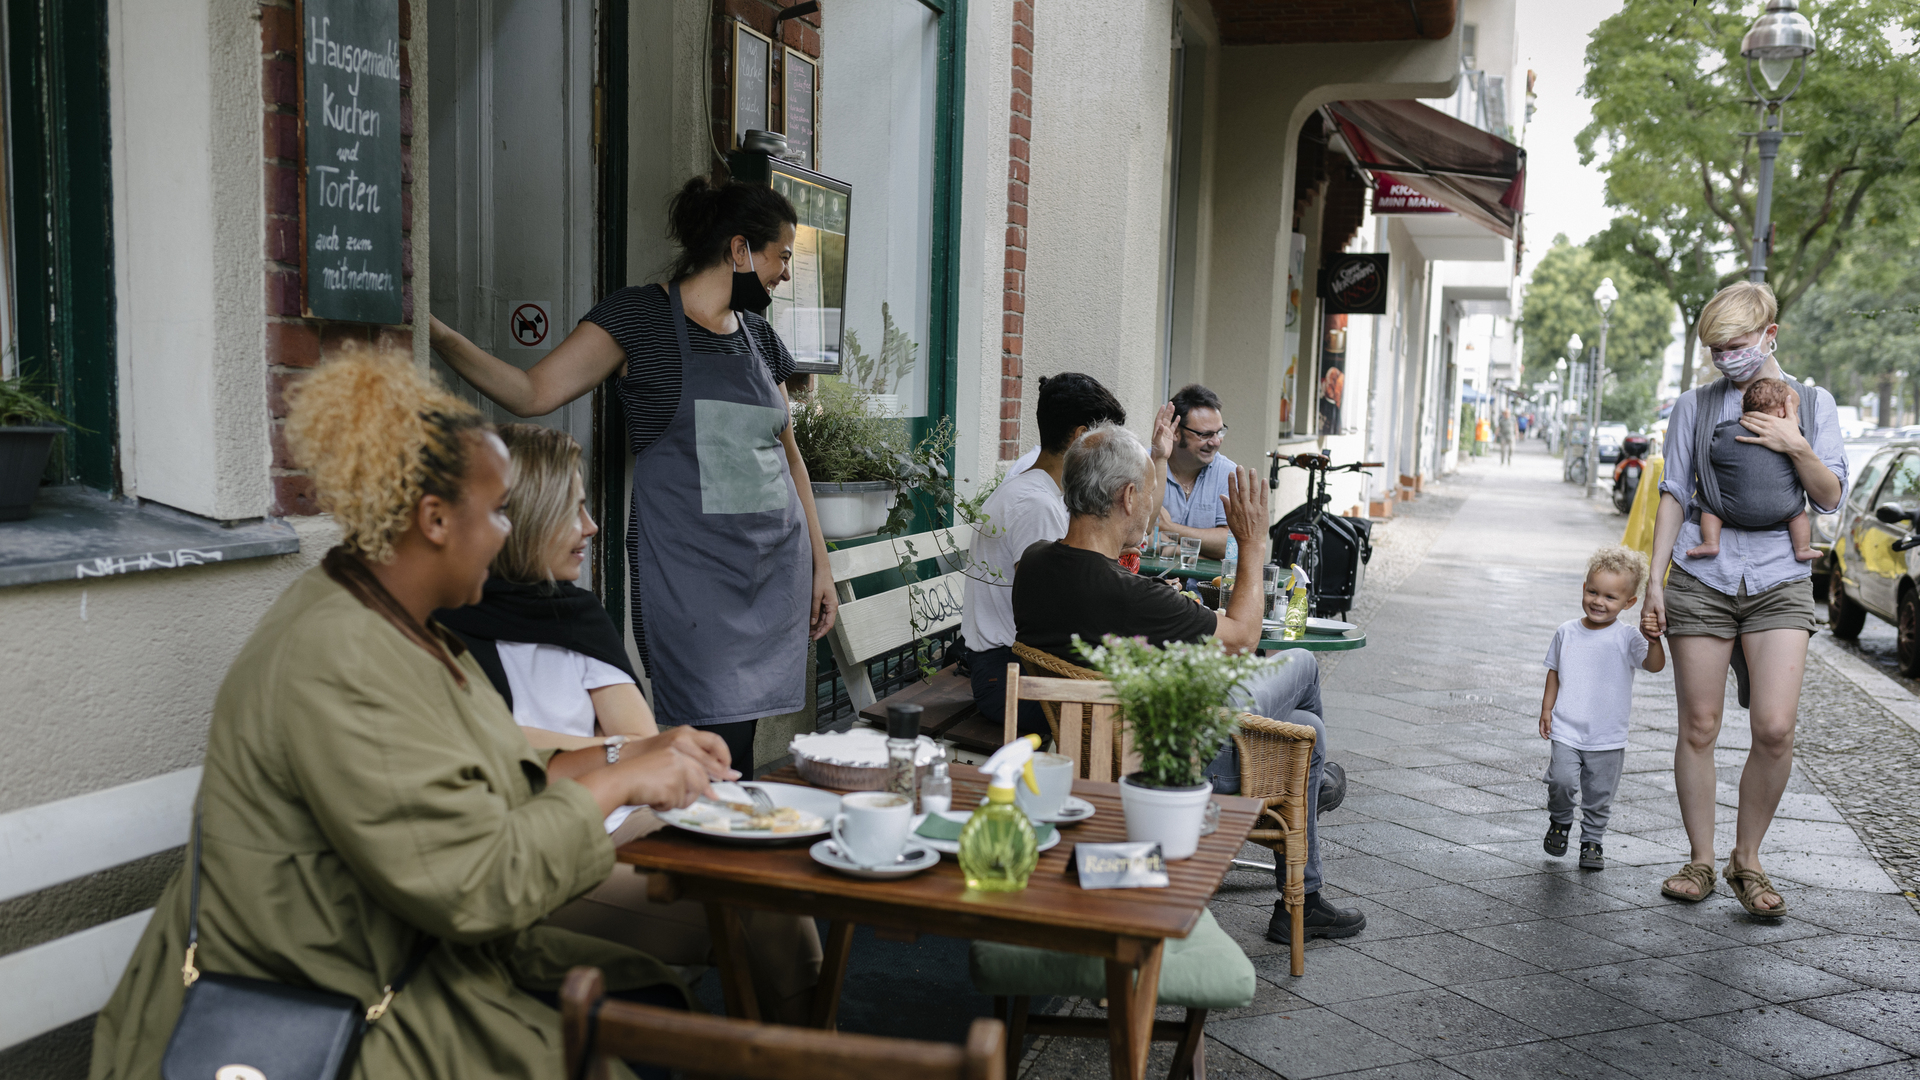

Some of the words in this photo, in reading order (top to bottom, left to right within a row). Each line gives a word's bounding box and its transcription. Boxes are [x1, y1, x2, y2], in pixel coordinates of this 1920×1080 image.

[322, 82, 380, 138] Kuchen
[336, 141, 360, 162] und
[315, 165, 381, 213] Torten
[1378, 197, 1406, 208] MINI
[315, 224, 340, 251] auch
[345, 236, 373, 251] zum
[322, 256, 394, 291] mitnehmen
